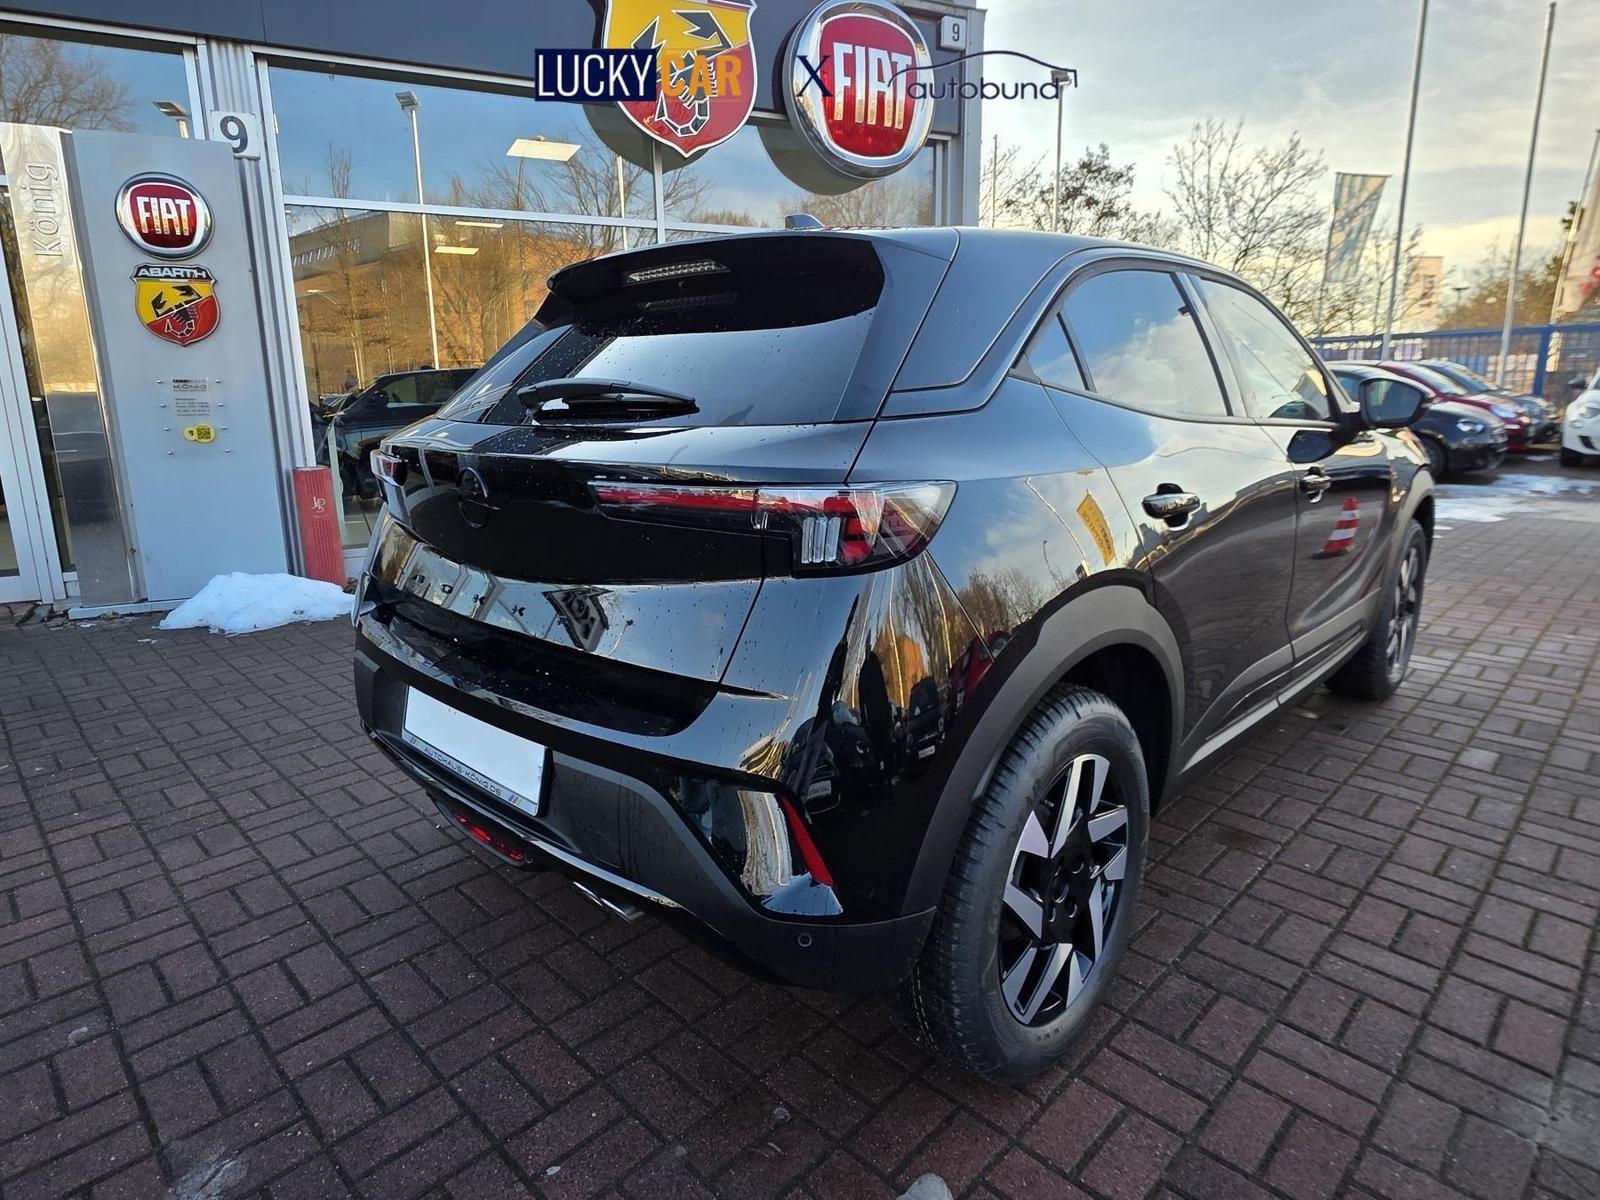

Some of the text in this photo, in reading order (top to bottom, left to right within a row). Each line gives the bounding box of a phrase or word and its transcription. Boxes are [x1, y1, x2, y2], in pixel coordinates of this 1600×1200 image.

[952, 22, 960, 42] 9
[832, 42, 912, 130] FIAT
[219, 114, 249, 154] 9
[20, 161, 64, 257] König
[136, 196, 192, 236] FIAT
[138, 267, 207, 278] ABARTH
